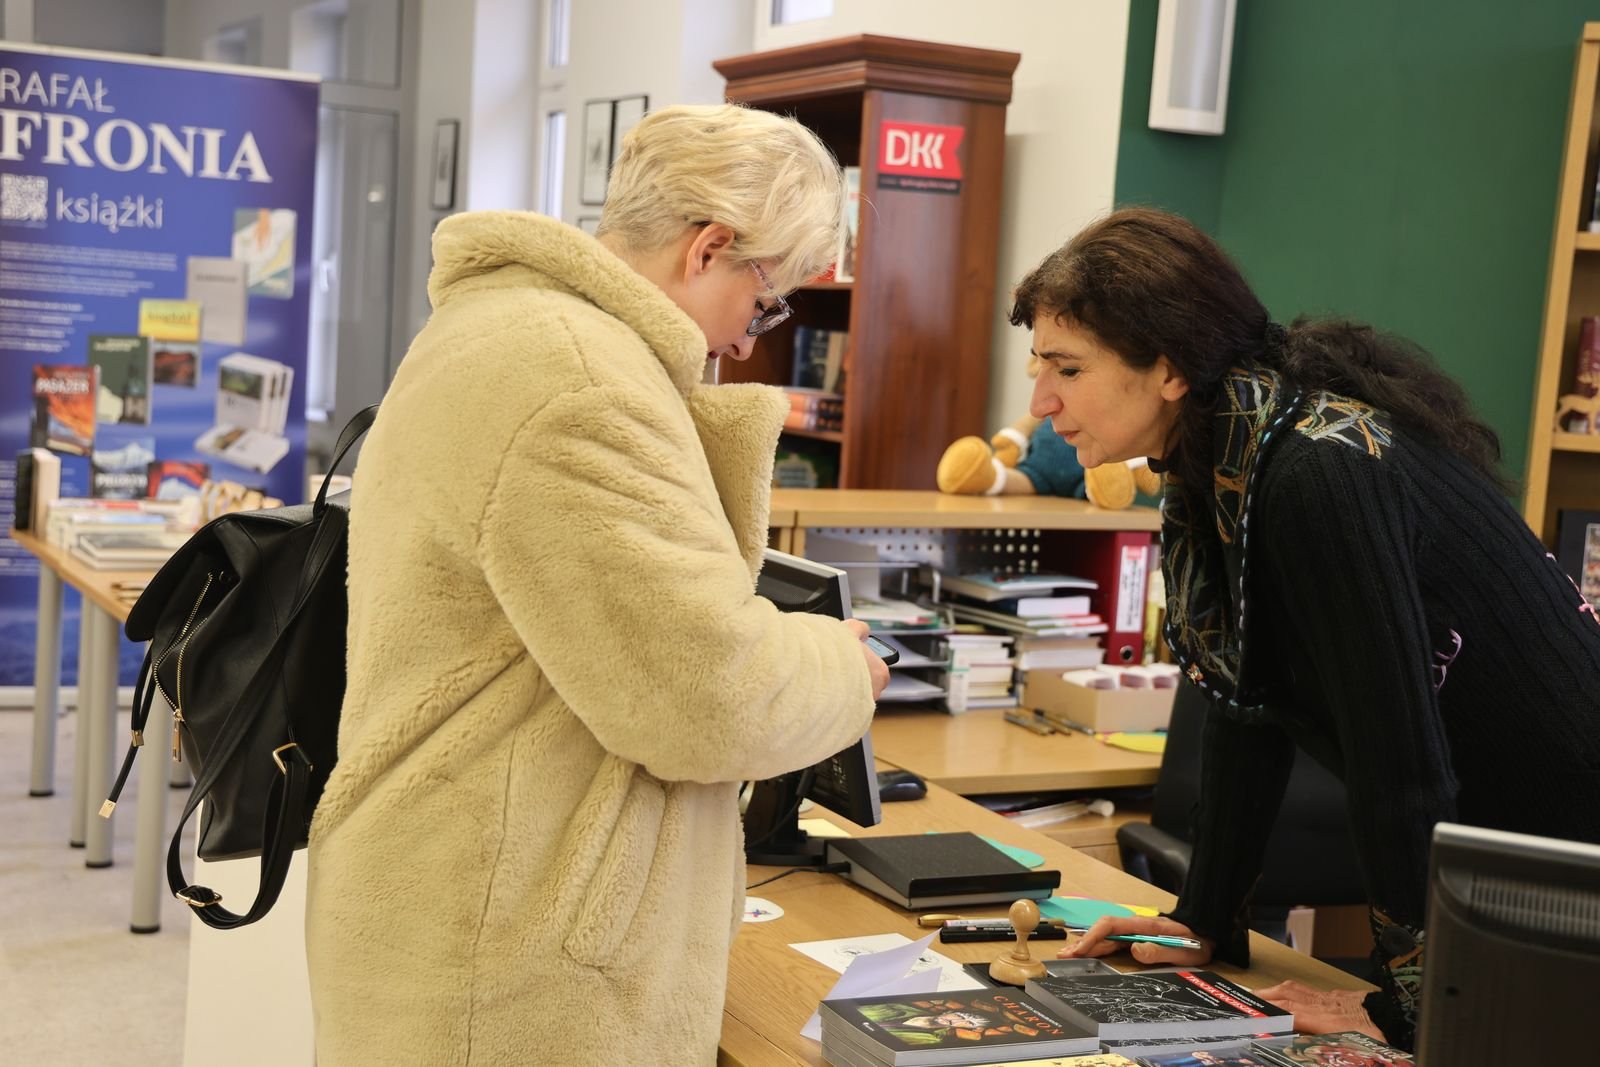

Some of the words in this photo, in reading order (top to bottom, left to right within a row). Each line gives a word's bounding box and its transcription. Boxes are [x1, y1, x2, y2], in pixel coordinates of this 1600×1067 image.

[0, 67, 115, 113] RAFAŁ
[0, 107, 273, 183] FRONIA
[885, 128, 945, 170] DKK
[55, 186, 164, 234] książki
[993, 995, 1064, 1035] CHARON
